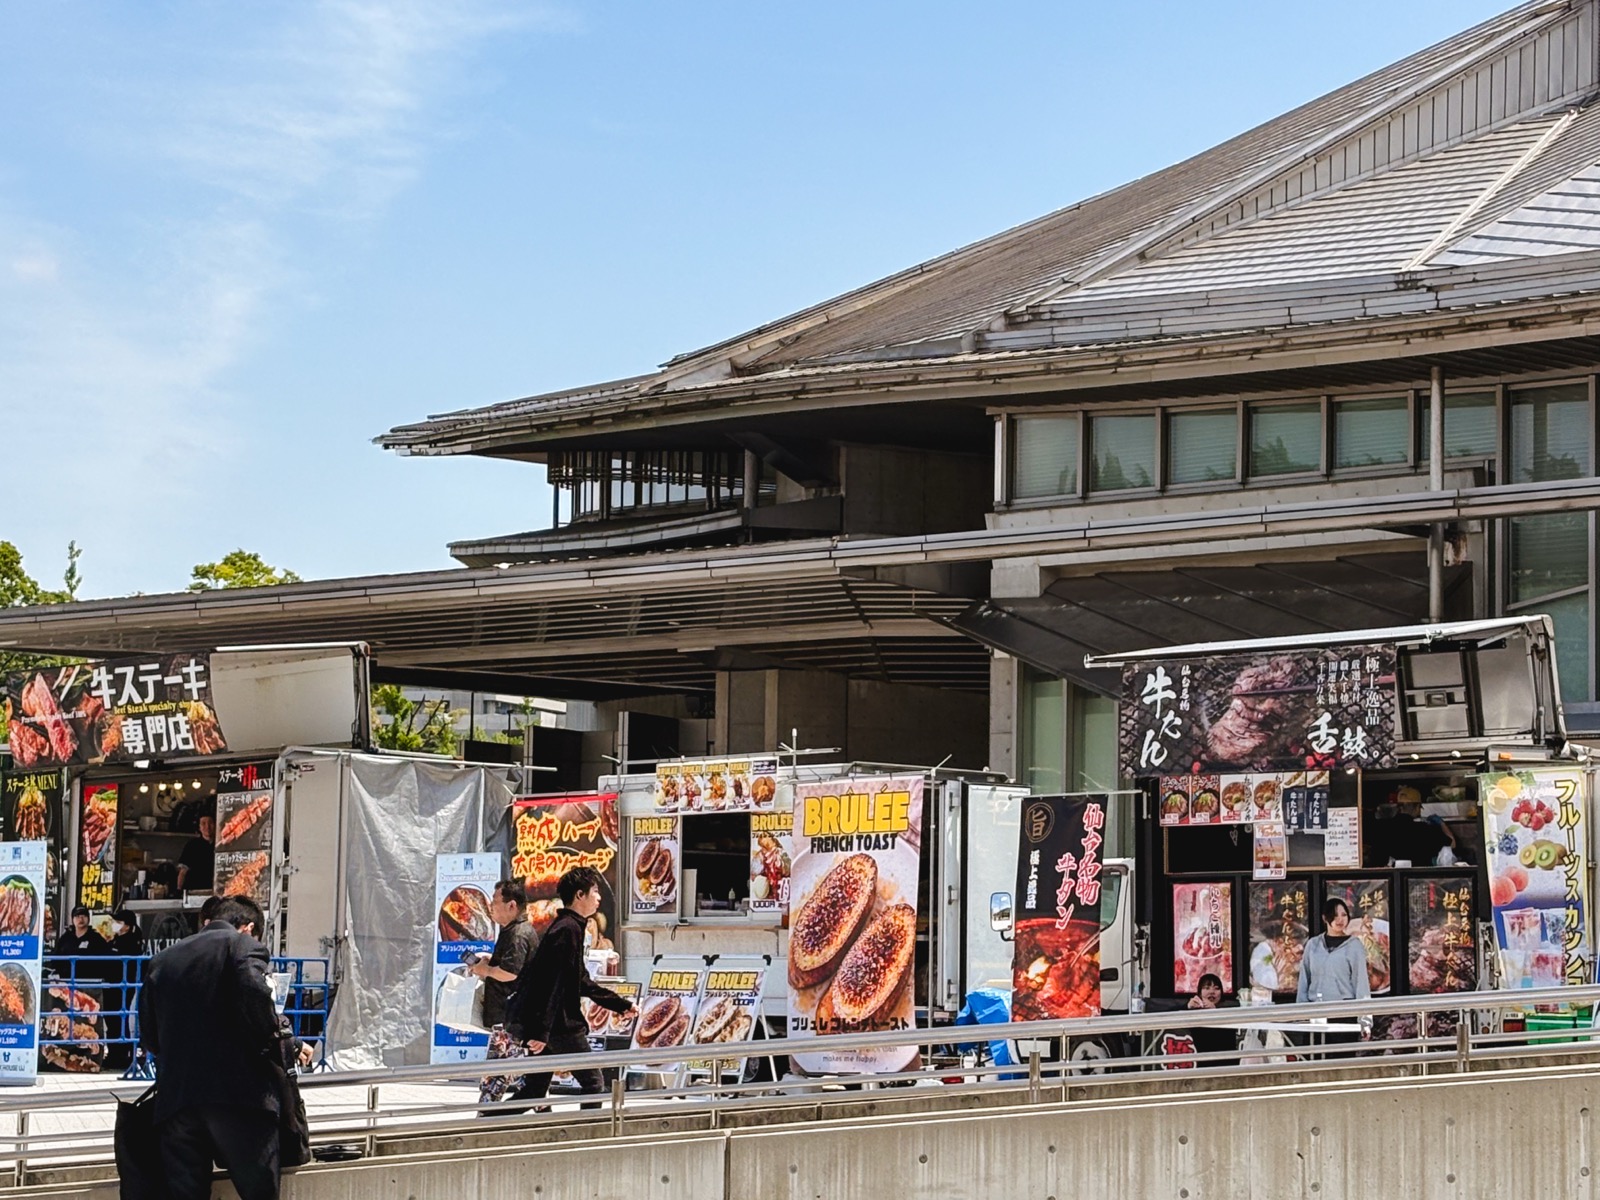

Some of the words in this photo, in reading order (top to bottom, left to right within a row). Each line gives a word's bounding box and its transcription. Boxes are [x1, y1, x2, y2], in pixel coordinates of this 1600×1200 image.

[91, 659, 206, 710] 牛ステーキ
[127, 702, 147, 713] Steak
[1365, 656, 1380, 726] 極上逸品
[121, 713, 196, 755] 専門店
[1140, 665, 1183, 768] 牛たん
[37, 773, 58, 790] MENU
[252, 778, 273, 789] MENU
[517, 813, 560, 851] 熟成
[562, 816, 601, 842] ハーブ
[803, 783, 911, 837] BRÛLÉE
[1032, 810, 1047, 837] 旨
[811, 836, 854, 854] FRENCH
[856, 833, 899, 851] TOAST
[1077, 803, 1104, 905] 仙台名物
[1055, 852, 1077, 928] 牛タン
[1443, 891, 1460, 987] 極上牛たん
[1458, 887, 1471, 945] 仙台名物
